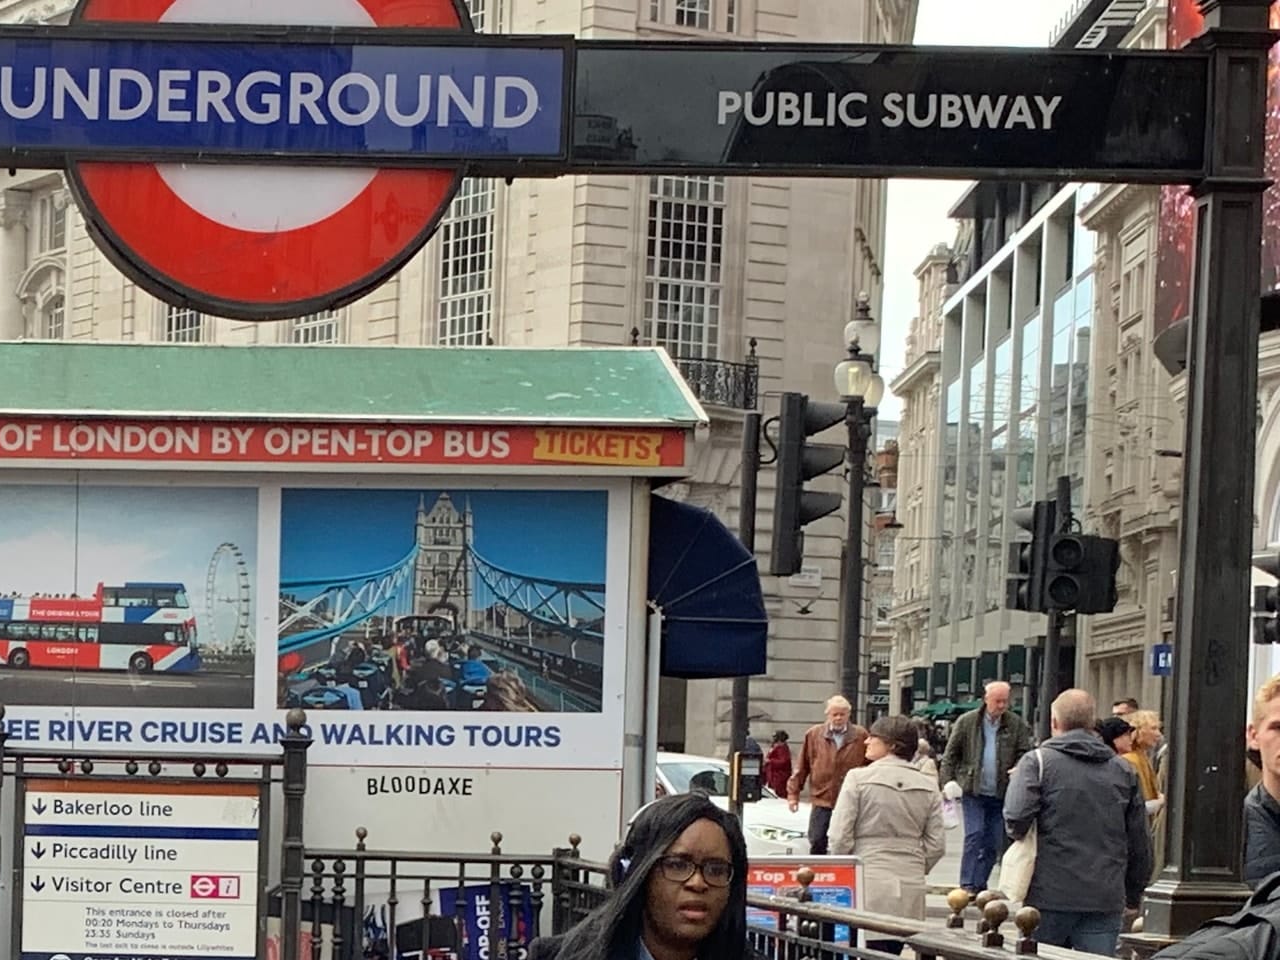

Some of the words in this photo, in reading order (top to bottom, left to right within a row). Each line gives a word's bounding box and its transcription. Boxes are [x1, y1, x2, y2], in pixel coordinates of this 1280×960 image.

[0, 65, 540, 128] UNDERGROUND
[717, 91, 869, 128] PUBLIC
[882, 94, 1063, 131] SUBWAY
[53, 424, 200, 455] LONDON
[211, 426, 255, 455] BY
[263, 428, 434, 458] OPEN-TOP
[443, 430, 511, 459] BUS
[537, 430, 654, 461] TICKETS
[48, 720, 130, 744] RIVER
[140, 721, 244, 745] CRUISE
[319, 723, 456, 747] WALKING
[461, 724, 563, 748] TOURS
[366, 775, 474, 797] BLOODAXE
[52, 799, 133, 816] Bakerloo
[140, 800, 174, 817] line
[51, 843, 138, 864] Piccadilly
[144, 845, 179, 861] line
[51, 876, 113, 893] Visitor
[119, 877, 184, 895] Centre
[753, 869, 785, 883] Top
[788, 869, 836, 883] Turs
[85, 907, 107, 917] This
[109, 909, 152, 918] entrance
[155, 909, 164, 918] is
[166, 909, 199, 919] closed
[201, 909, 227, 920] after
[85, 918, 113, 928] 00:20
[116, 919, 160, 930] Mondays
[163, 920, 174, 929] to
[178, 920, 231, 932] Thursdays
[115, 929, 156, 940] Sundays
